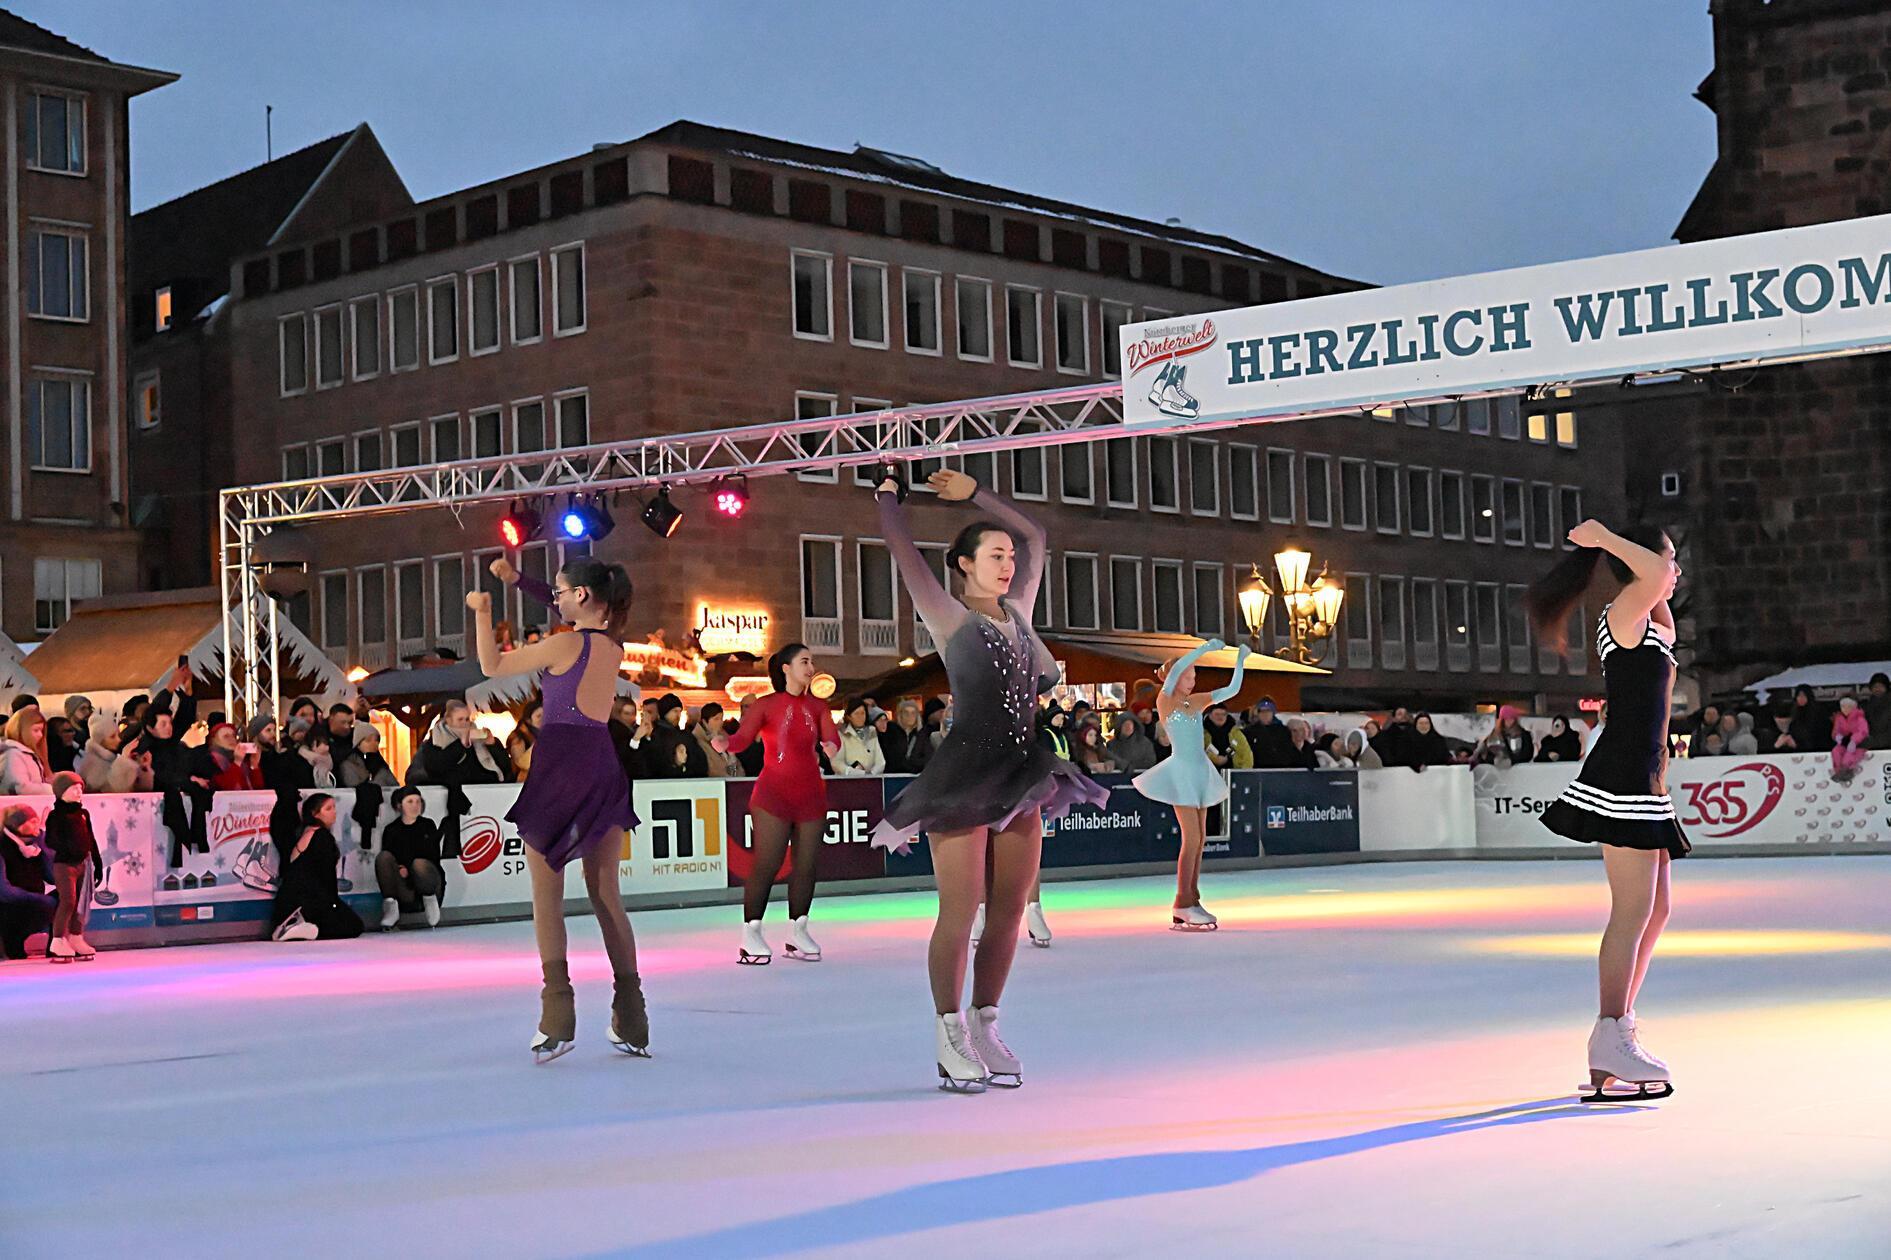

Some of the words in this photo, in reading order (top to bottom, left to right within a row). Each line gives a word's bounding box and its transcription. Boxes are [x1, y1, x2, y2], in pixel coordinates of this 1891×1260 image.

[1126, 319, 1216, 369] Winterwelt
[1227, 302, 1532, 385] HERZLICH
[703, 607, 768, 634] kaspar
[1287, 804, 1353, 822] TeilhaberBank
[1681, 781, 1748, 826] 365
[653, 864, 670, 875] HIT
[673, 862, 708, 873] RADIO
